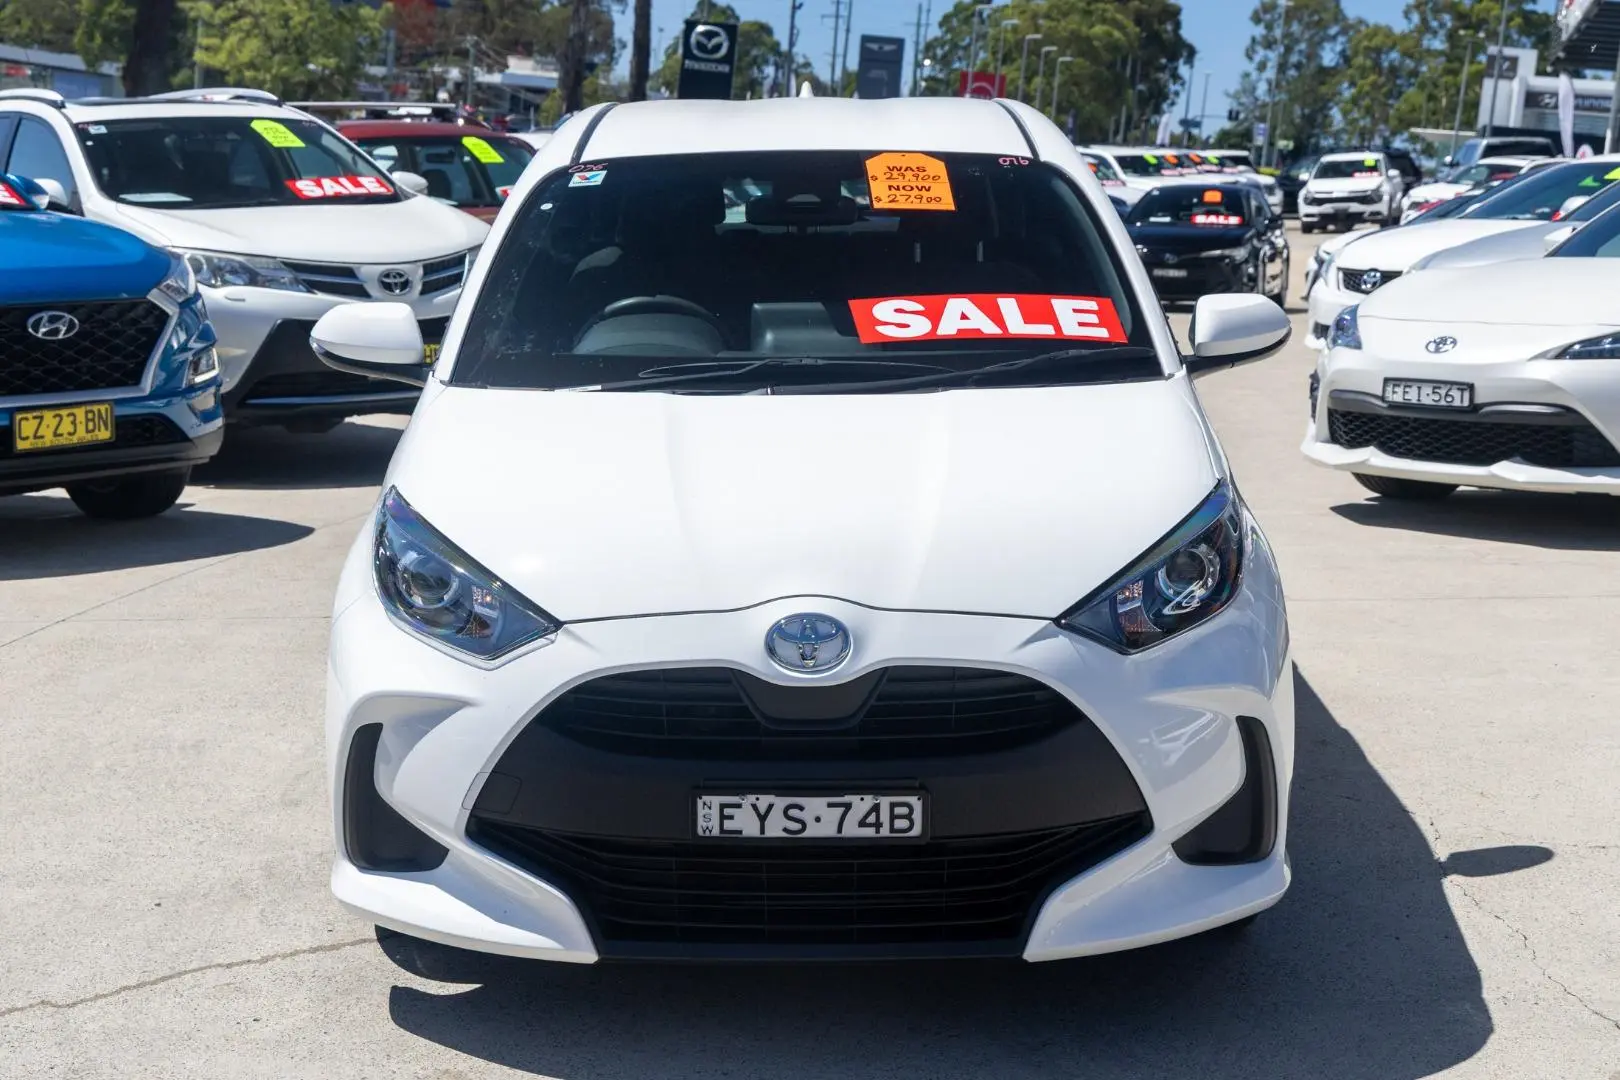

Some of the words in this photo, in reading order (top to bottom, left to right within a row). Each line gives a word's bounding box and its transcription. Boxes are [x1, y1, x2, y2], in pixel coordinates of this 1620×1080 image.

[886, 165, 928, 173] WAS
[295, 176, 388, 198] SALE
[887, 184, 932, 192] NOW
[1194, 214, 1242, 225] SALE
[872, 297, 1110, 338] SALE
